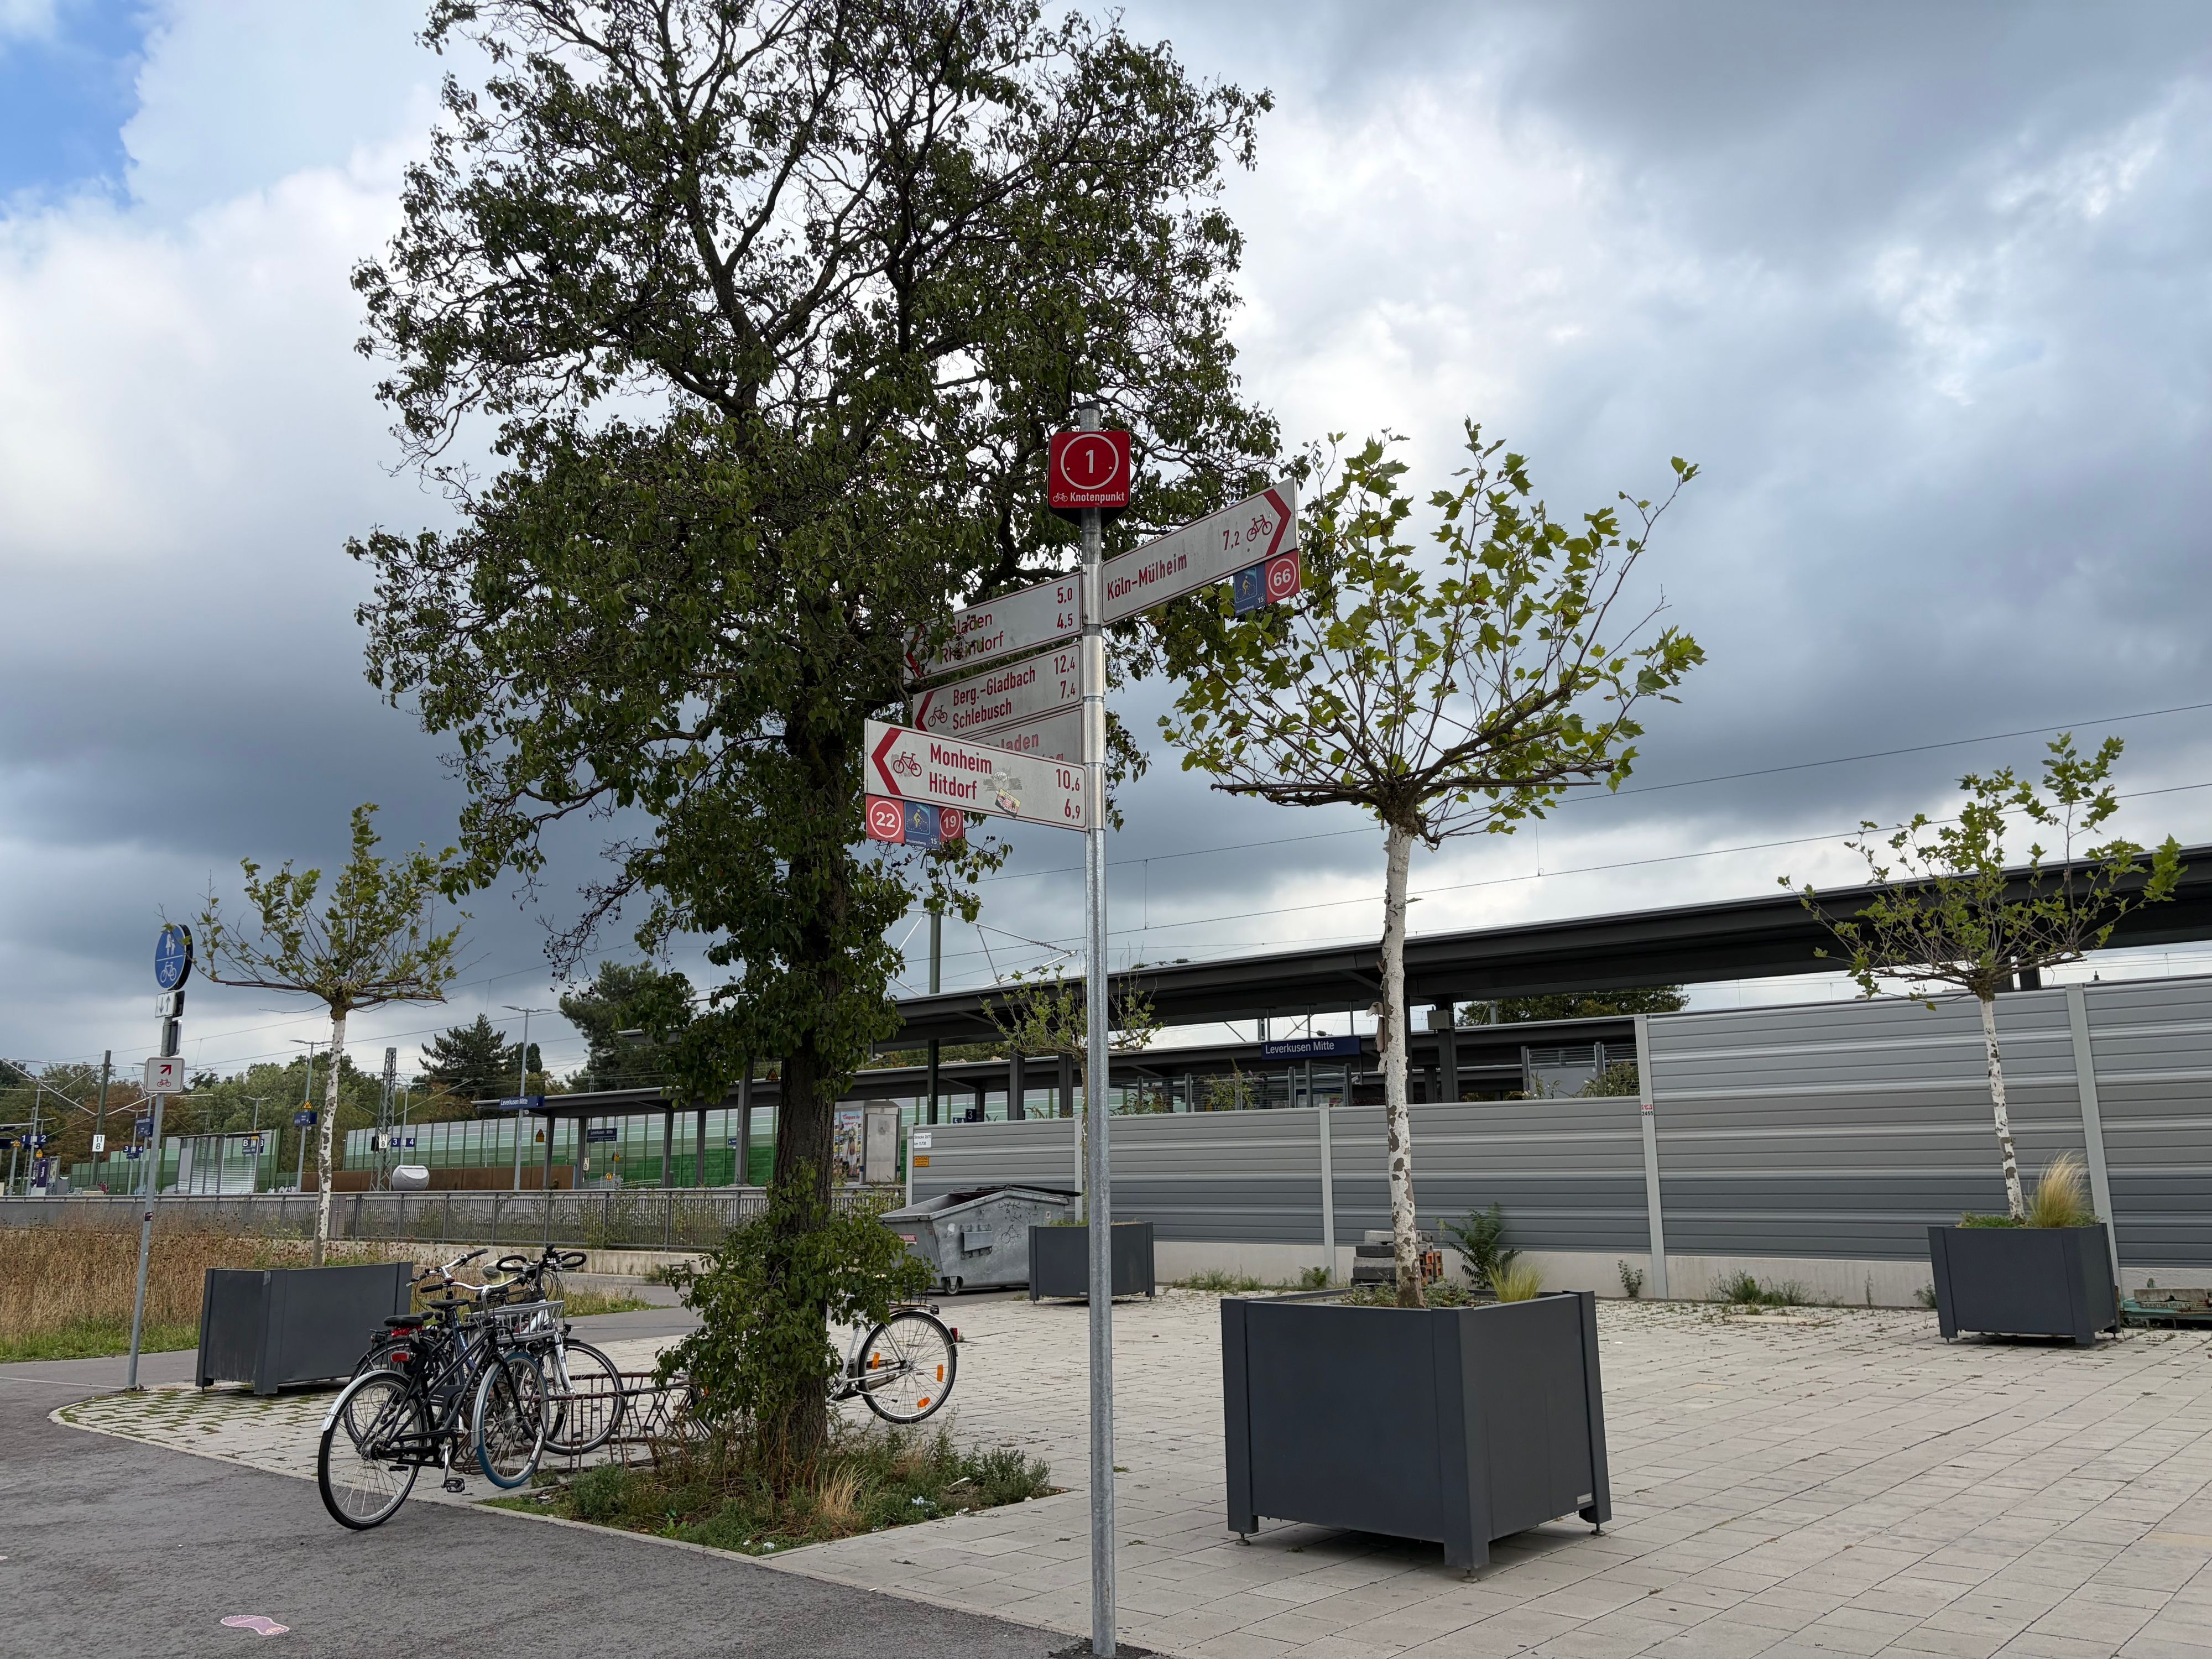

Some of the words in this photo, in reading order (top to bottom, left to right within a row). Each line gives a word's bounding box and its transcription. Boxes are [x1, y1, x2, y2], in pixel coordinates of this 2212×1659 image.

[1086, 450, 1094, 473] 1
[1070, 492, 1125, 504] Knotenpunkt
[1107, 554, 1187, 601] Köln-Mülheim
[1223, 529, 1240, 551] 7,2
[1274, 568, 1291, 587] 66
[1057, 587, 1073, 604] 5,0
[1057, 612, 1073, 629] 4,5
[953, 665, 1036, 707] Berg.-Gladbach
[1053, 654, 1076, 675] 12,4
[952, 697, 1012, 731] Schlebusch
[1060, 680, 1076, 700] 7,4
[930, 742, 992, 775] Monheim
[1055, 769, 1080, 792] 10,6
[929, 771, 977, 800] Hitdorf
[1064, 798, 1081, 820] 6,9
[875, 811, 896, 828] 22
[943, 815, 957, 829] 19
[1265, 1044, 1311, 1055] Leverkusen
[1313, 1041, 1335, 1051] Mitte
[968, 1110, 973, 1120] 3
